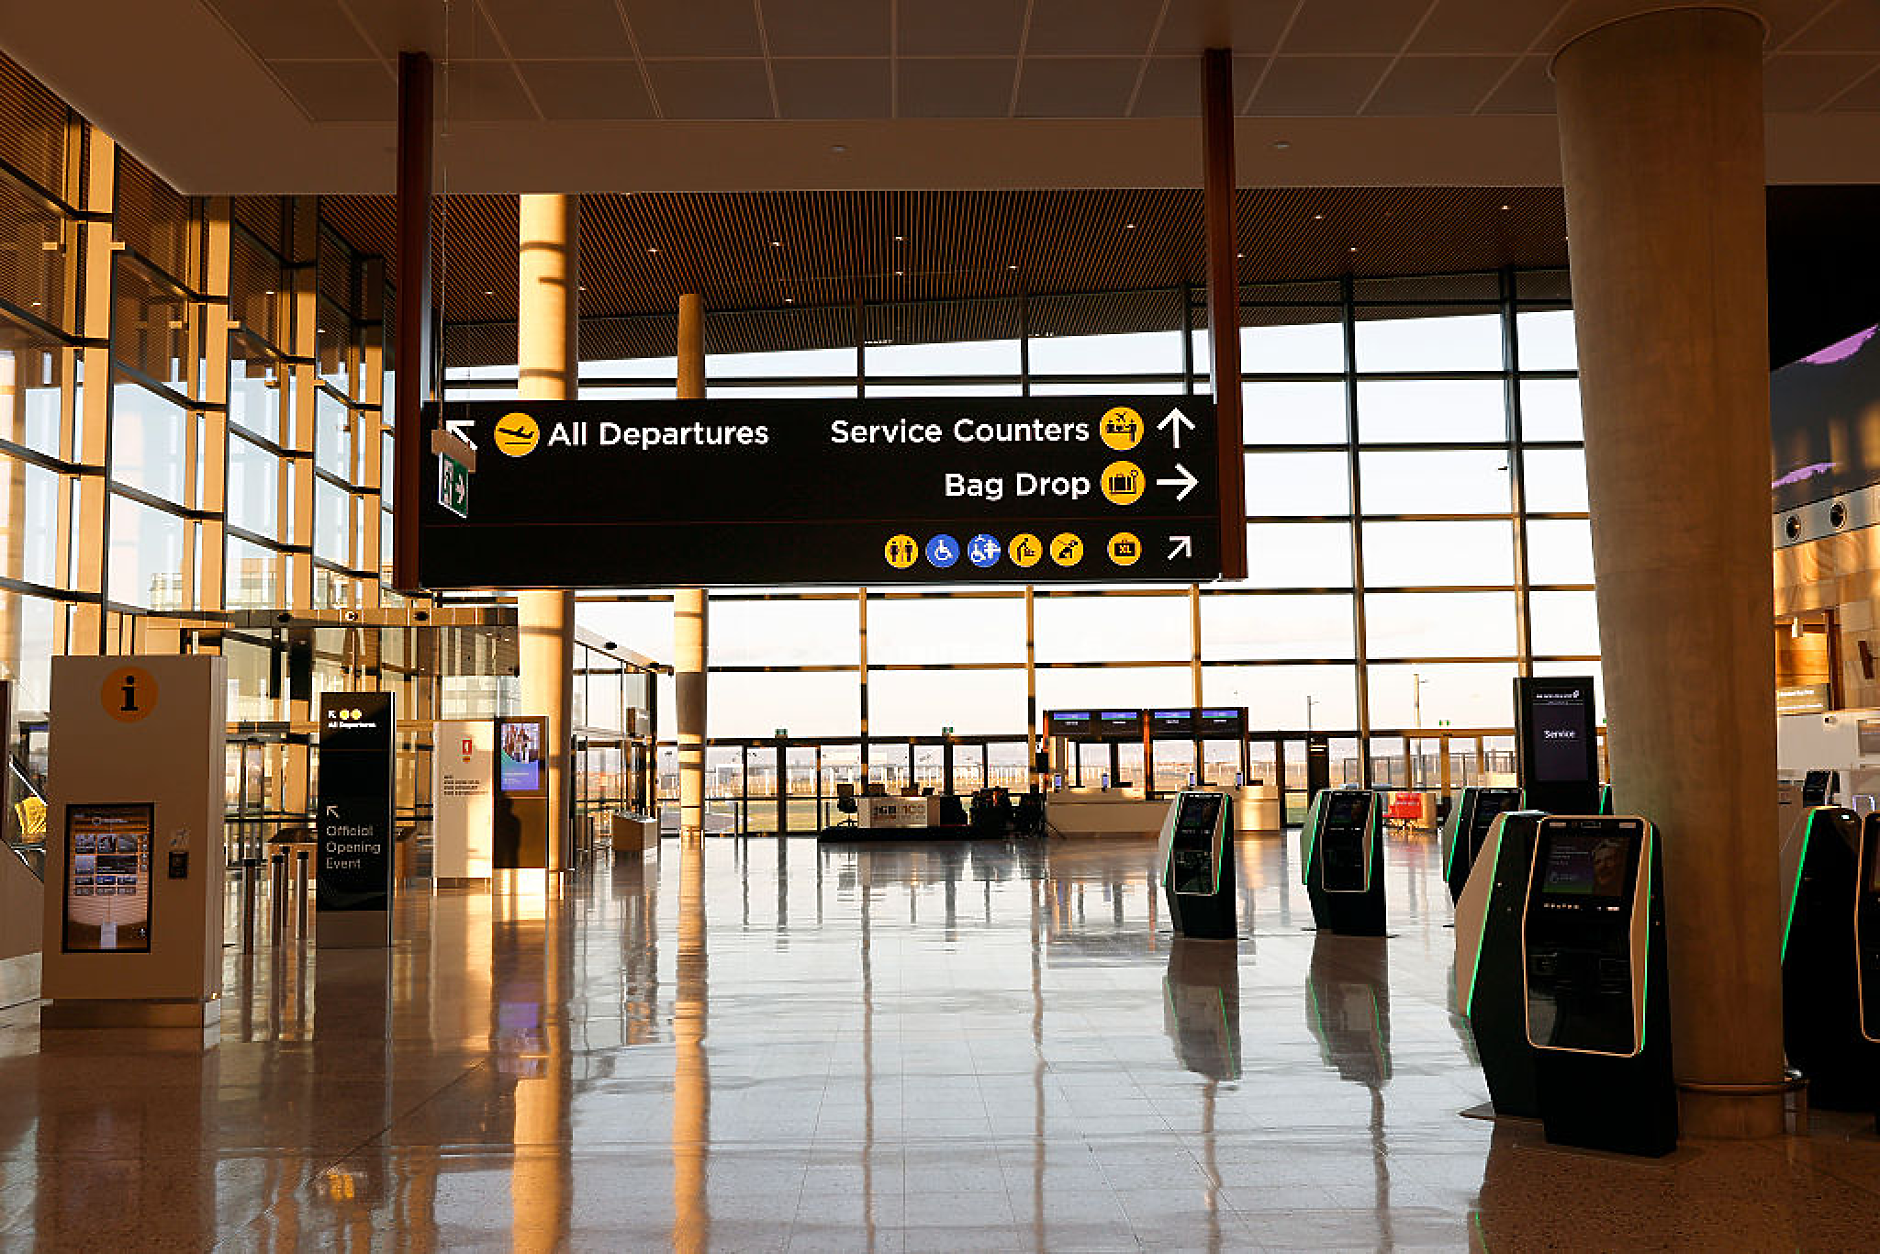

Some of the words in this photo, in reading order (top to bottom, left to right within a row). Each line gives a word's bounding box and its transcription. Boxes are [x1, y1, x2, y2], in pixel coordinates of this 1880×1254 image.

[547, 421, 587, 447] All
[599, 421, 770, 451] Departures
[831, 418, 943, 444] Service
[953, 418, 1090, 443] Counters
[945, 473, 1003, 502] Bag
[1016, 472, 1091, 500] Drop
[1119, 544, 1132, 554] XL
[1543, 730, 1576, 739] Service
[326, 825, 374, 836] Official
[326, 841, 381, 855] Opening
[326, 857, 361, 869] Event
